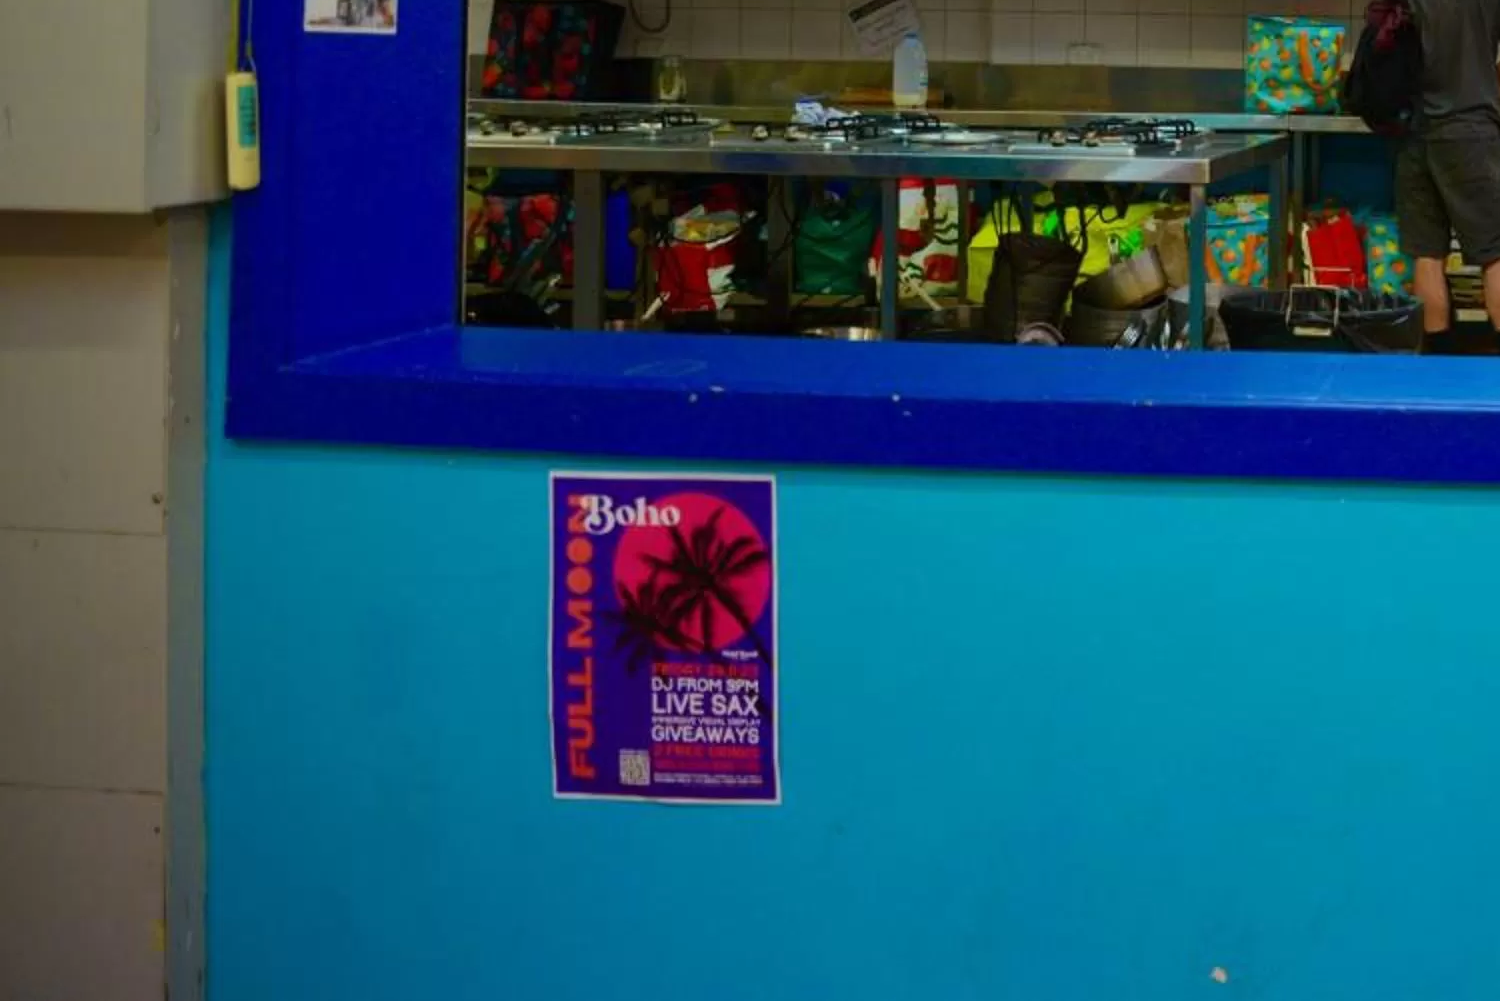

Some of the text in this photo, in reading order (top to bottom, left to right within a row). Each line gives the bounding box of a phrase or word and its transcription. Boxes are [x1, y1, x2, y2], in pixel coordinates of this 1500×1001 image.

[579, 494, 681, 535] Boho
[651, 676, 673, 692] DJ
[677, 677, 722, 692] FROM
[652, 693, 759, 716] LIVE SAX
[567, 656, 595, 779] FULL
[651, 725, 759, 744] GIVEAWAYS
